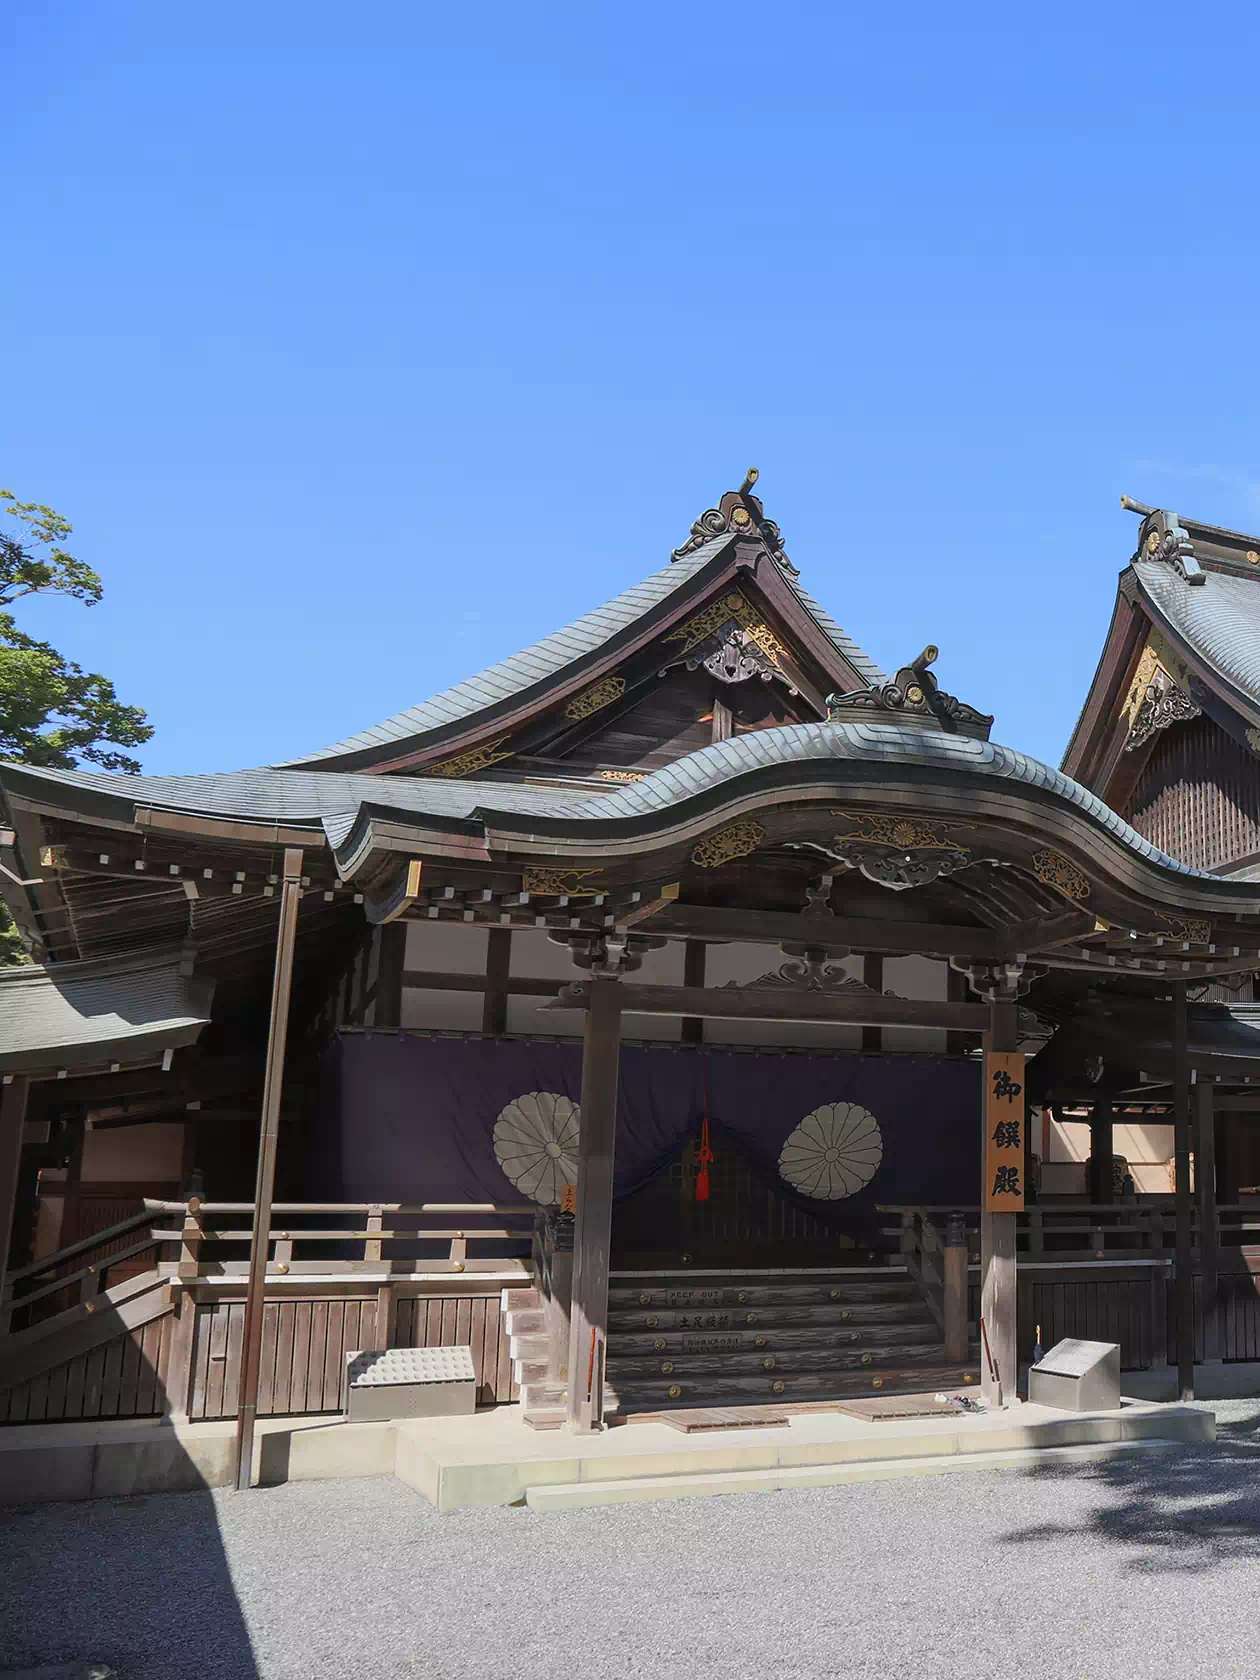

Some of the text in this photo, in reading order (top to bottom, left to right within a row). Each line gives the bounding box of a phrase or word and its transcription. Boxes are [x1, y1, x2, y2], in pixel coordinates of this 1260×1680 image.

[991, 1070, 1022, 1197] 御饌殿
[671, 1290, 719, 1299] KEEP OUT
